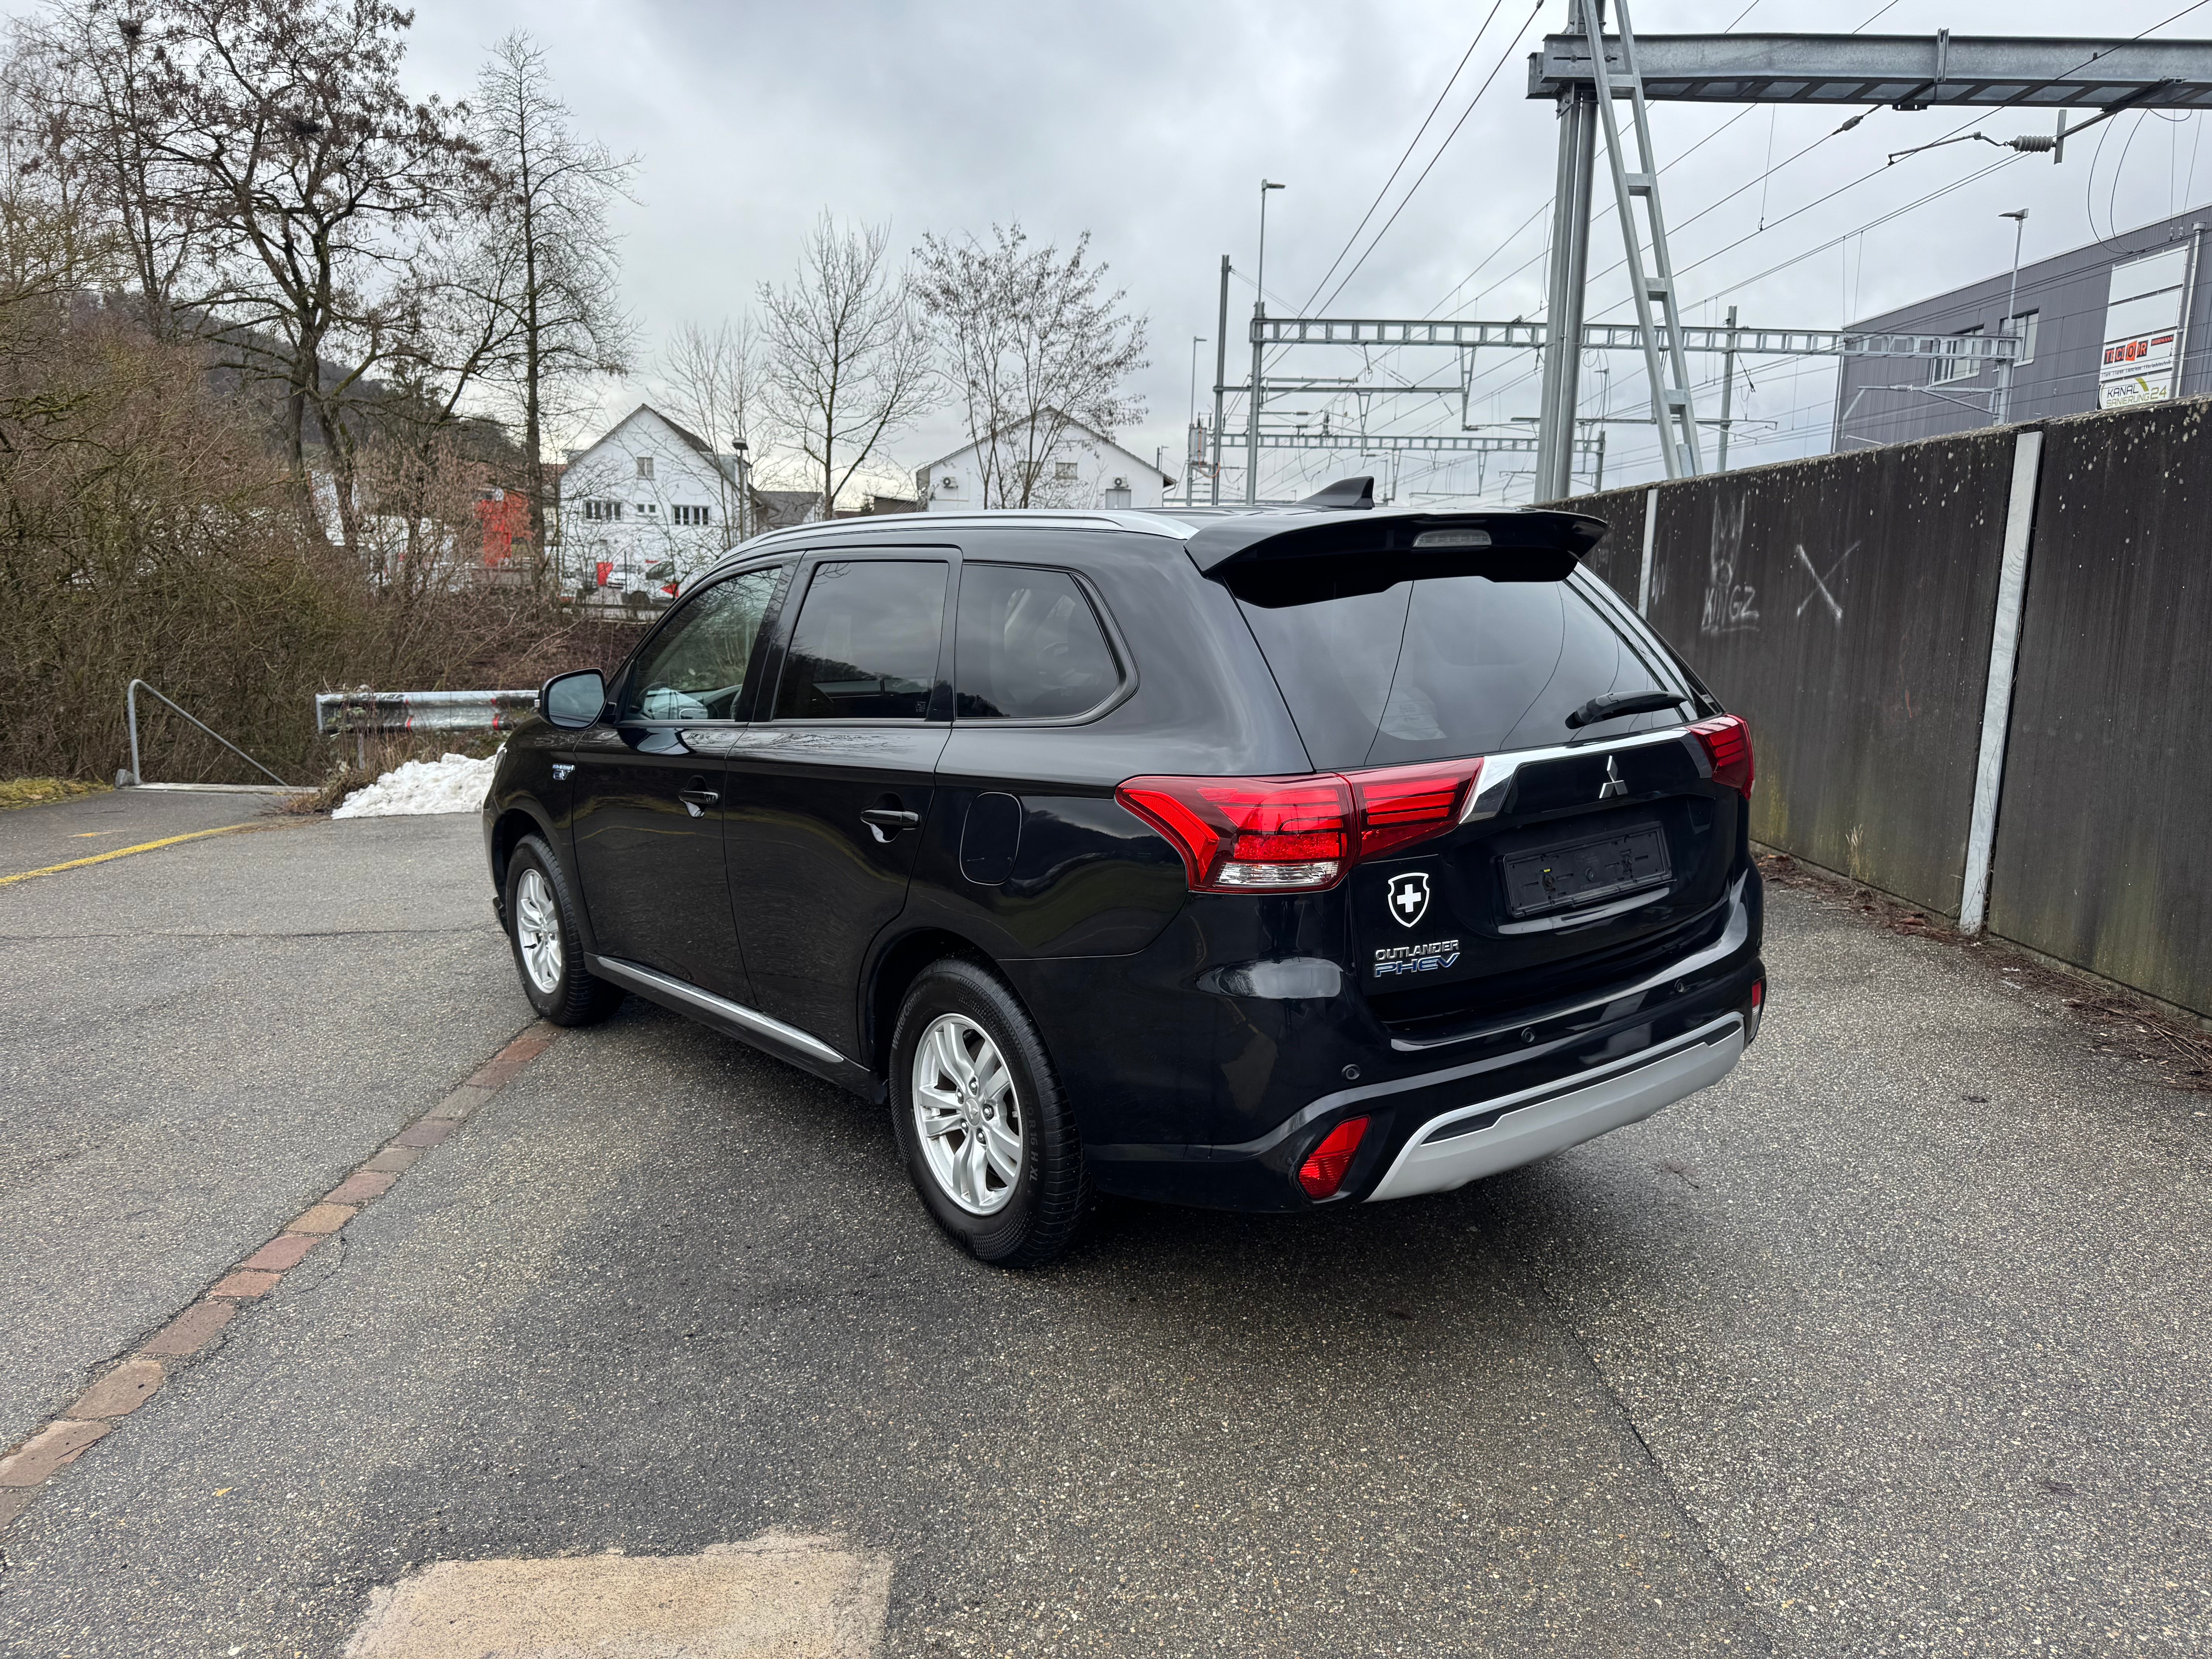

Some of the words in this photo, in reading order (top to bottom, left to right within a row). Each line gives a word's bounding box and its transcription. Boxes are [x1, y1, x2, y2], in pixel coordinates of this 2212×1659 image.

[2106, 393, 2150, 407] SANIERUNG
[2150, 385, 2167, 400] 24
[2107, 384, 2139, 398] KANAL
[1375, 939, 1460, 961] OUTLANDER
[1373, 952, 1460, 978] PHEV
[1030, 1151, 1039, 1163] H
[1029, 1165, 1039, 1181] XL
